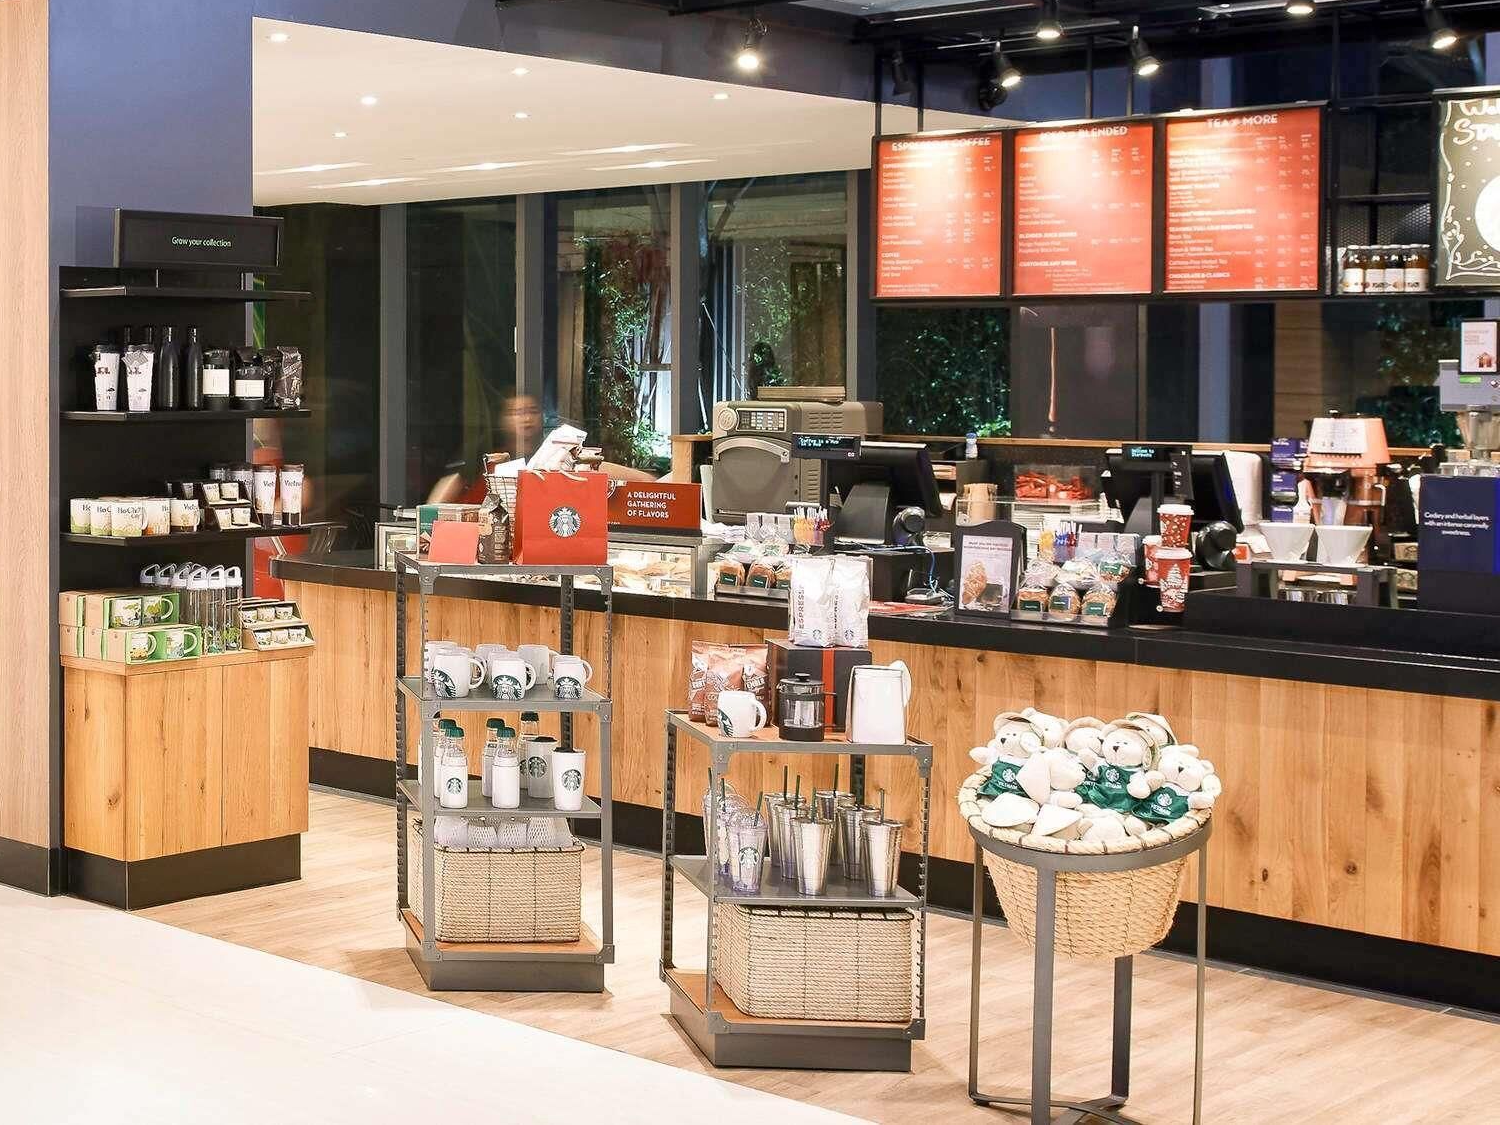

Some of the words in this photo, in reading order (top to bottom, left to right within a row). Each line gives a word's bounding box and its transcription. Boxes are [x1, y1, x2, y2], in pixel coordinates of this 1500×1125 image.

[1242, 114, 1278, 125] MORE
[1078, 126, 1128, 138] BLENDED
[203, 238, 231, 247] collection
[633, 491, 676, 500] DELIGHTFUL
[627, 500, 667, 509] GATHERING
[638, 510, 669, 518] FLAVORS
